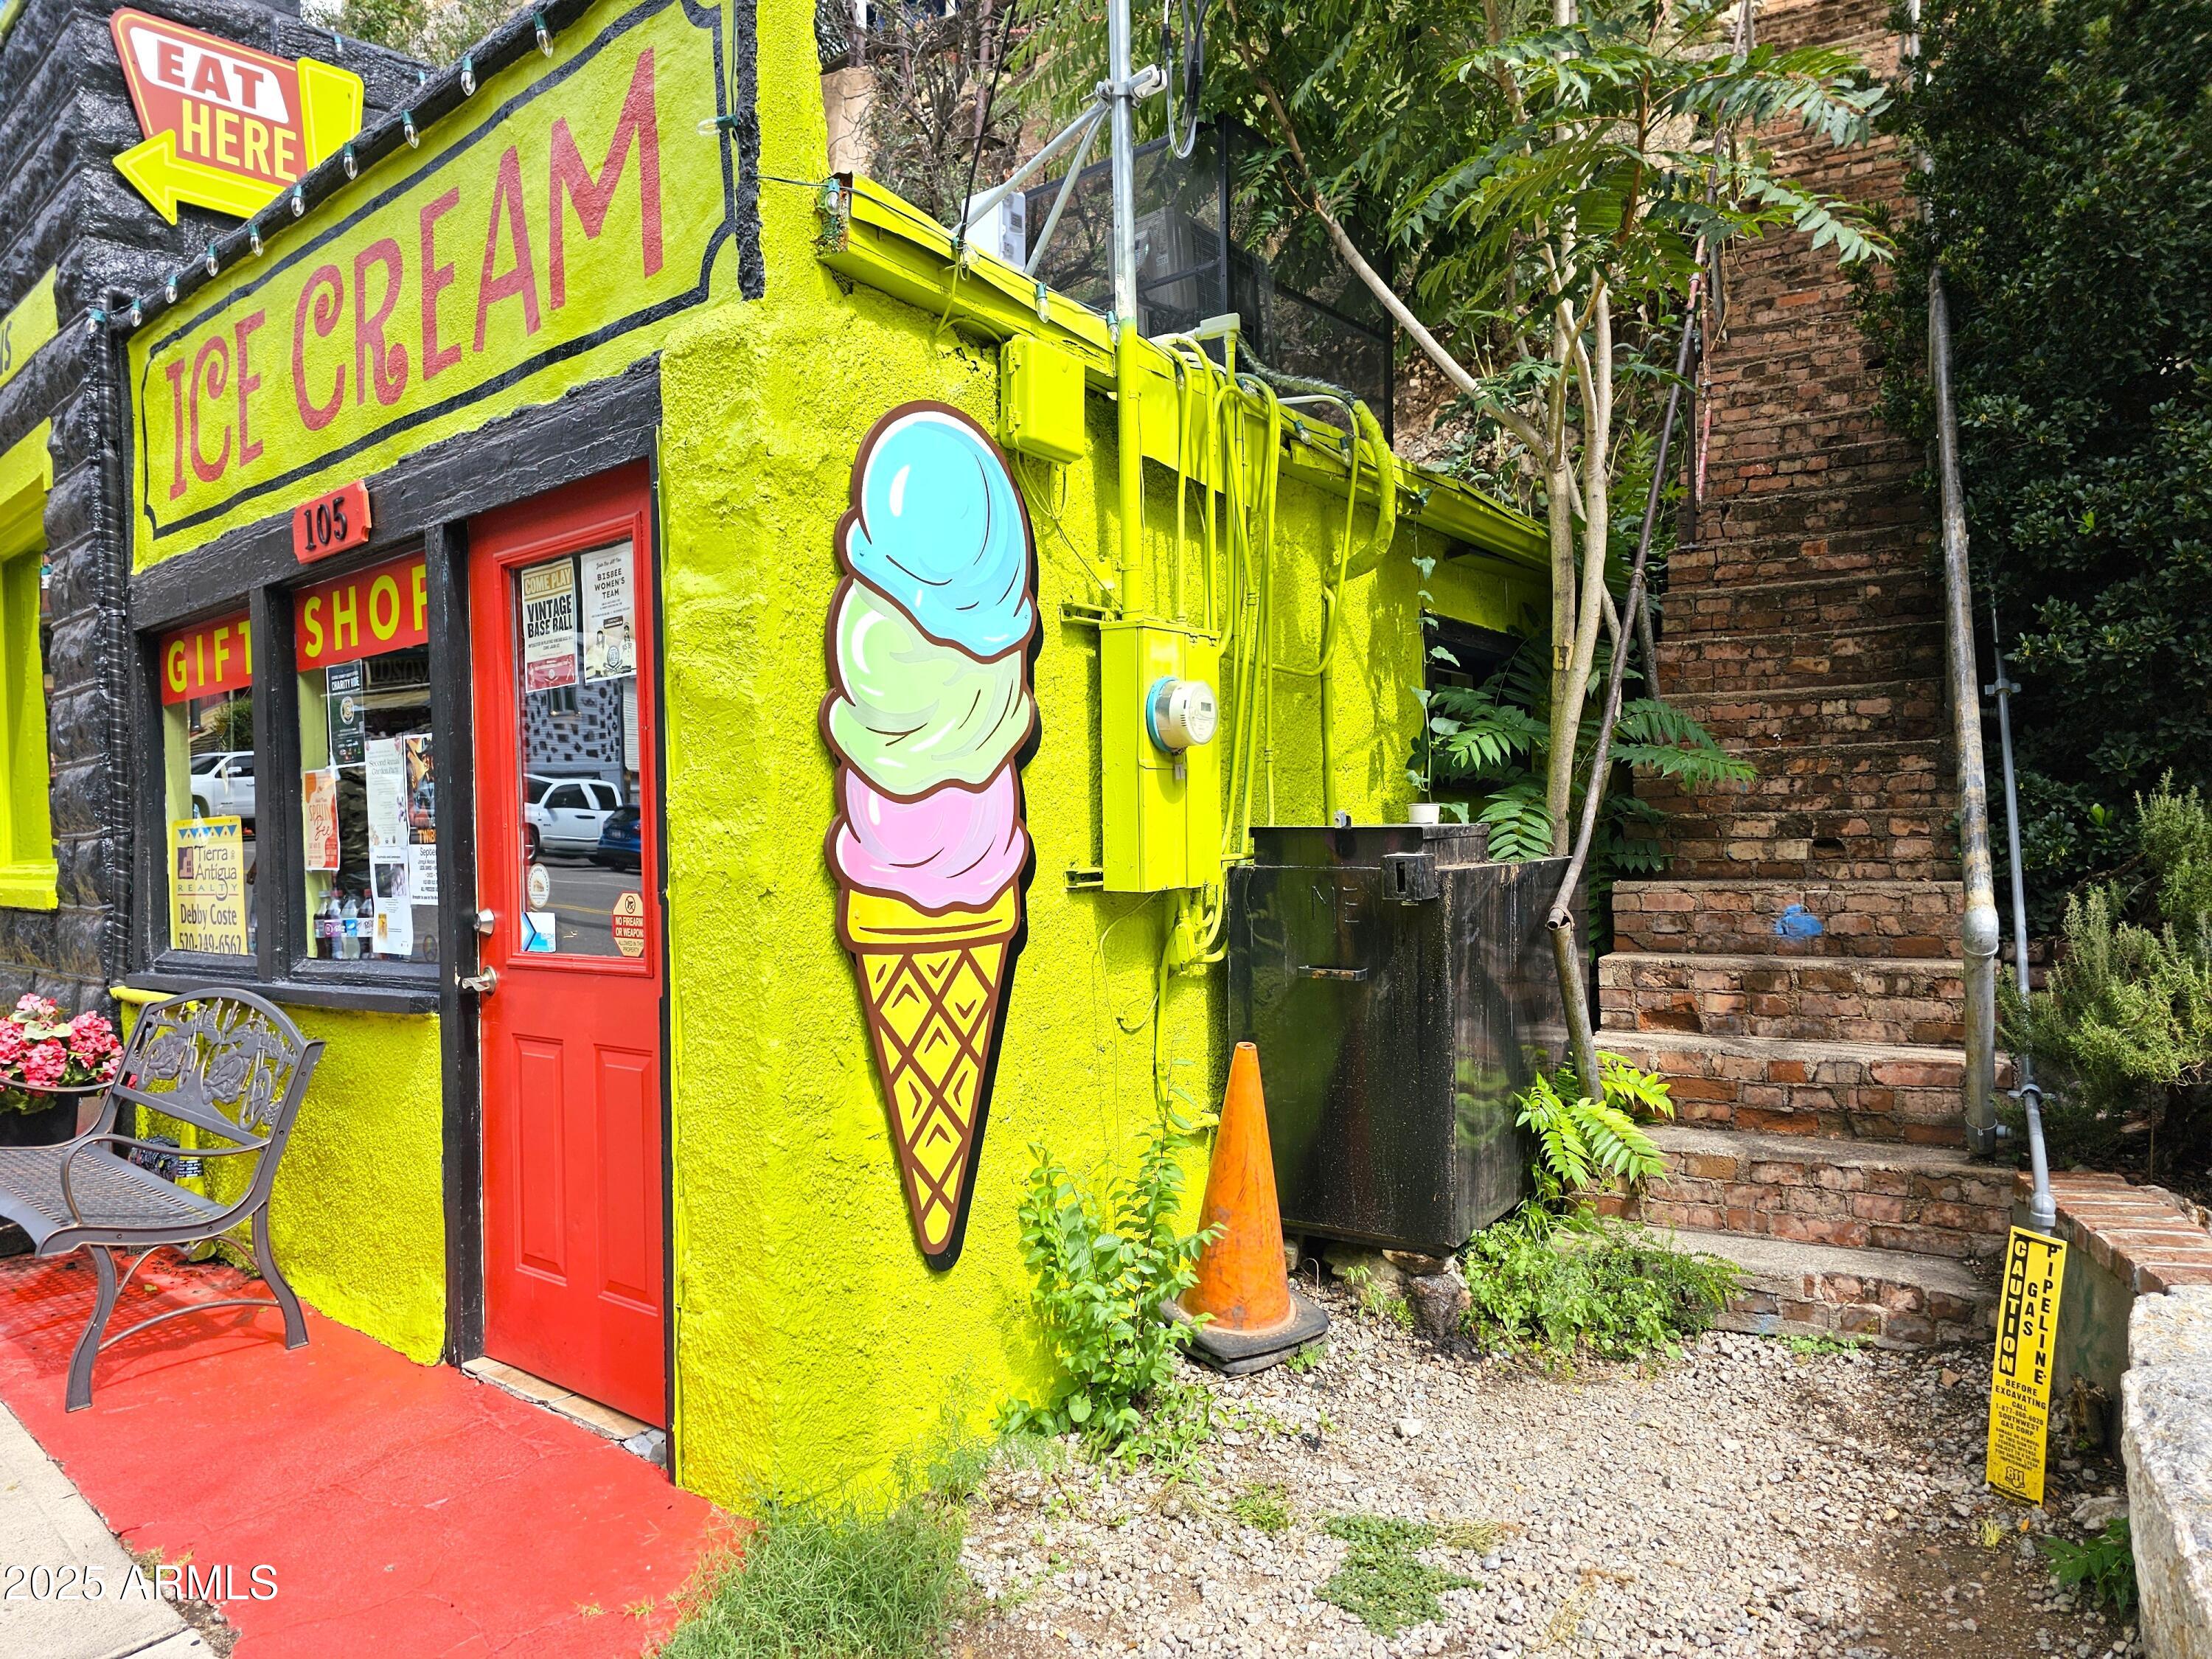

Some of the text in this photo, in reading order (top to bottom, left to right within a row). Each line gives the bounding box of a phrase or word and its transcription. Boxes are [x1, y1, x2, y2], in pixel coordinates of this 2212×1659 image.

[157, 40, 263, 110] EAT
[182, 99, 297, 182] HERE
[165, 47, 663, 501] ICE CREAM
[303, 495, 347, 550] 105
[524, 566, 572, 596] COME PLAY
[594, 577, 625, 591] WOMEN'S
[597, 568, 622, 581] BISBEE
[602, 588, 619, 599] TEAM
[527, 594, 572, 622] VINTAGE
[527, 614, 572, 638] BASE BALL
[332, 678, 350, 691] CHARITY
[417, 829, 437, 844] TWIB
[194, 845, 228, 862] Tierra
[420, 846, 437, 858] Septe
[178, 884, 238, 892] REALTY
[195, 863, 237, 901] Antigua
[181, 903, 237, 930] Debby Coste
[615, 917, 622, 925] NO
[615, 928, 622, 936] OR
[2001, 1240, 2027, 1373] CAUTION
[2023, 1282, 2038, 1337] GAS
[2034, 1245, 2058, 1385] PIPELINE
[1995, 1385, 2046, 1410] EXCAVATING
[2006, 1379, 2037, 1397] BEFORE
[1996, 1402, 2043, 1425] 1-877-860-6020
[2012, 1401, 2027, 1412] CALL
[1998, 1411, 2039, 1431] SOUTHWEST
[2000, 1419, 2036, 1438] GAS CORP.
[2006, 1466, 2025, 1484] 811
